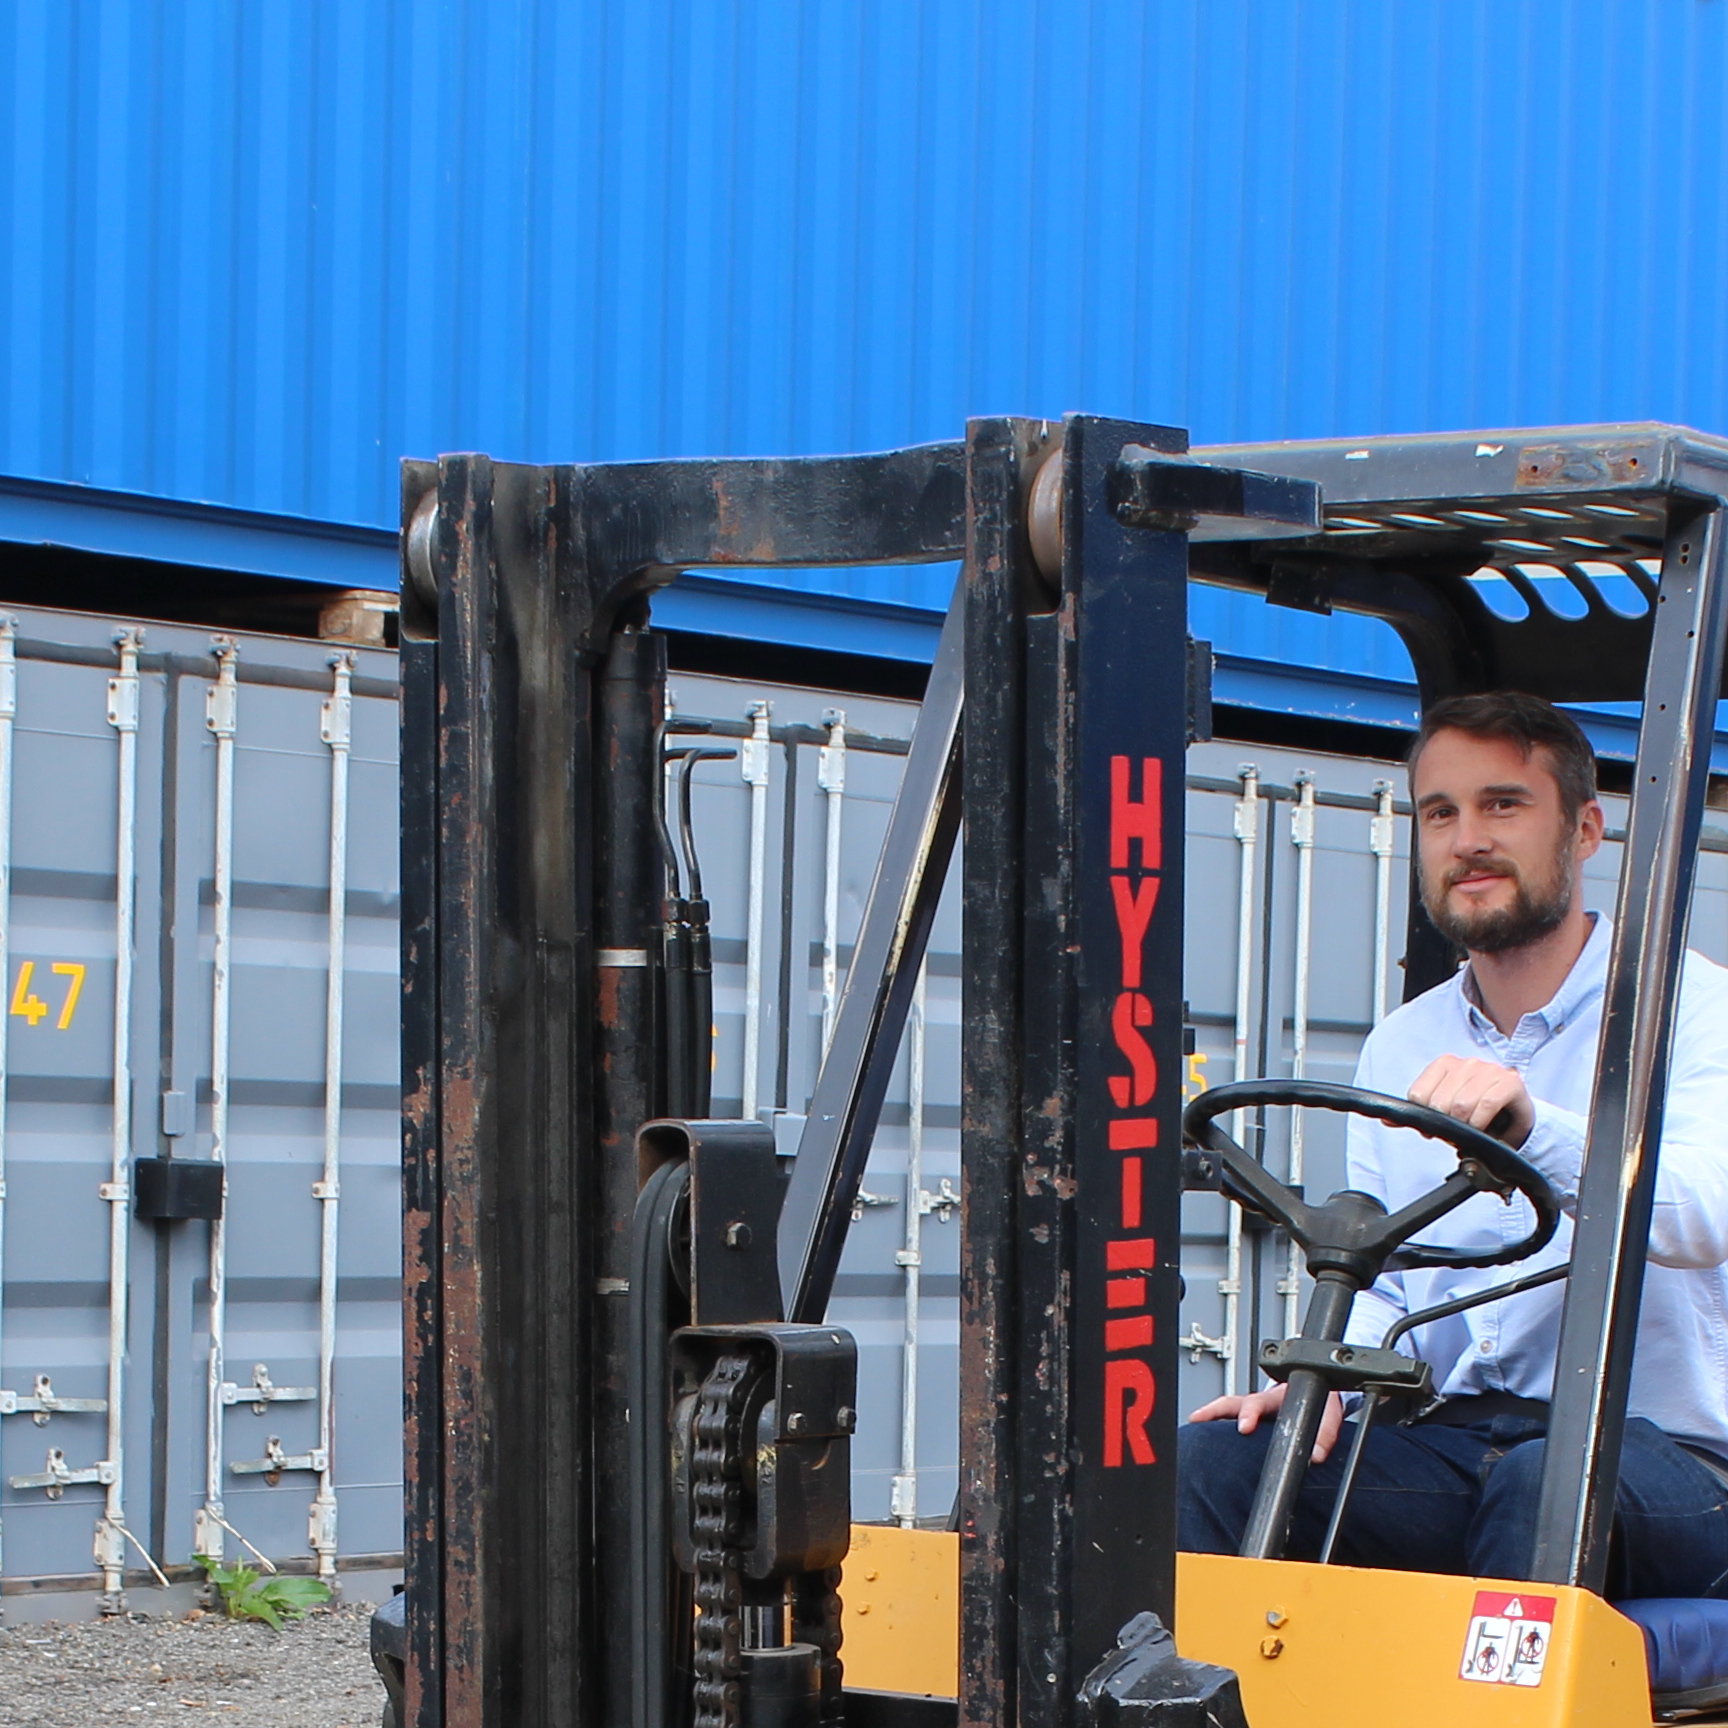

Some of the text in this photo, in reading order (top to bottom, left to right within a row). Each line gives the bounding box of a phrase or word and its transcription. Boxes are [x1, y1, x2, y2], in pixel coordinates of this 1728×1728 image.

[9, 961, 86, 1030] 47
[1103, 756, 1161, 1467] HYSTER
[1181, 1053, 1209, 1103] 5
